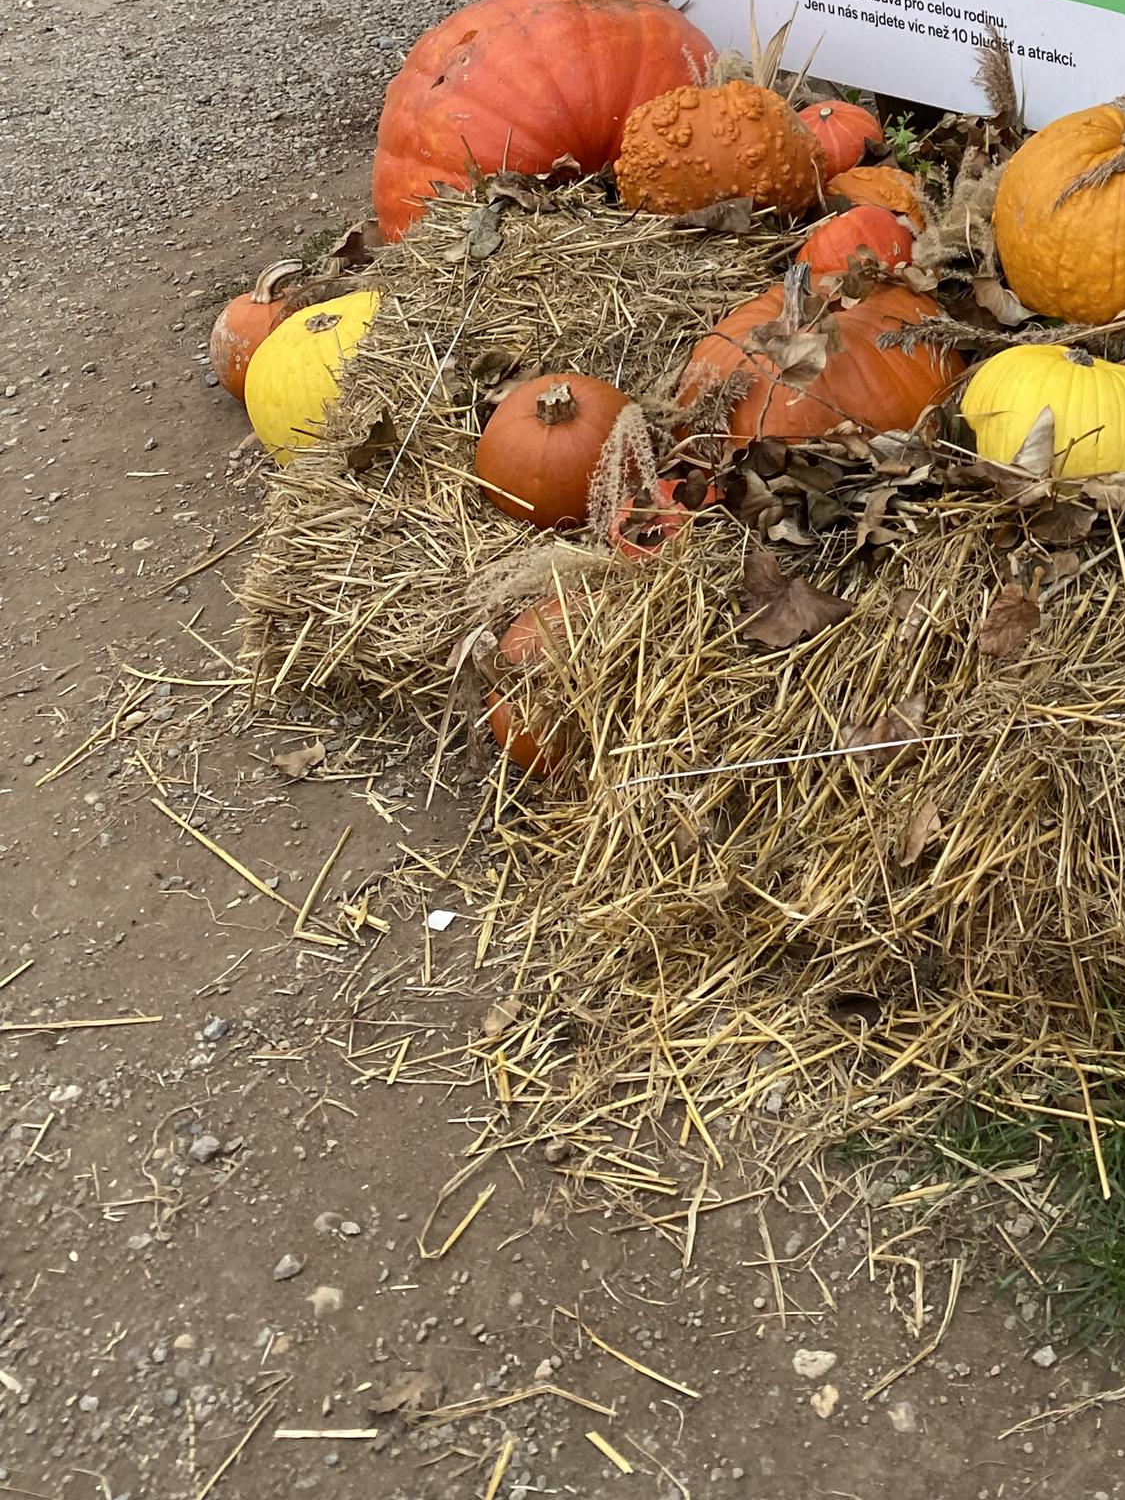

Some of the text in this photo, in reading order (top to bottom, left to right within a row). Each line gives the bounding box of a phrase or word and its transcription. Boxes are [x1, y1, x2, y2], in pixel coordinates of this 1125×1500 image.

[828, 4, 835, 15] u
[838, 4, 858, 20] nás
[861, 10, 905, 29] najdete
[908, 19, 926, 34] víc
[928, 24, 950, 40] než
[951, 28, 968, 44] 10
[1017, 44, 1025, 57] a
[1028, 47, 1077, 67] atrakcí.
[927, 1, 961, 19] celou
[964, 9, 1008, 29] rodinu.
